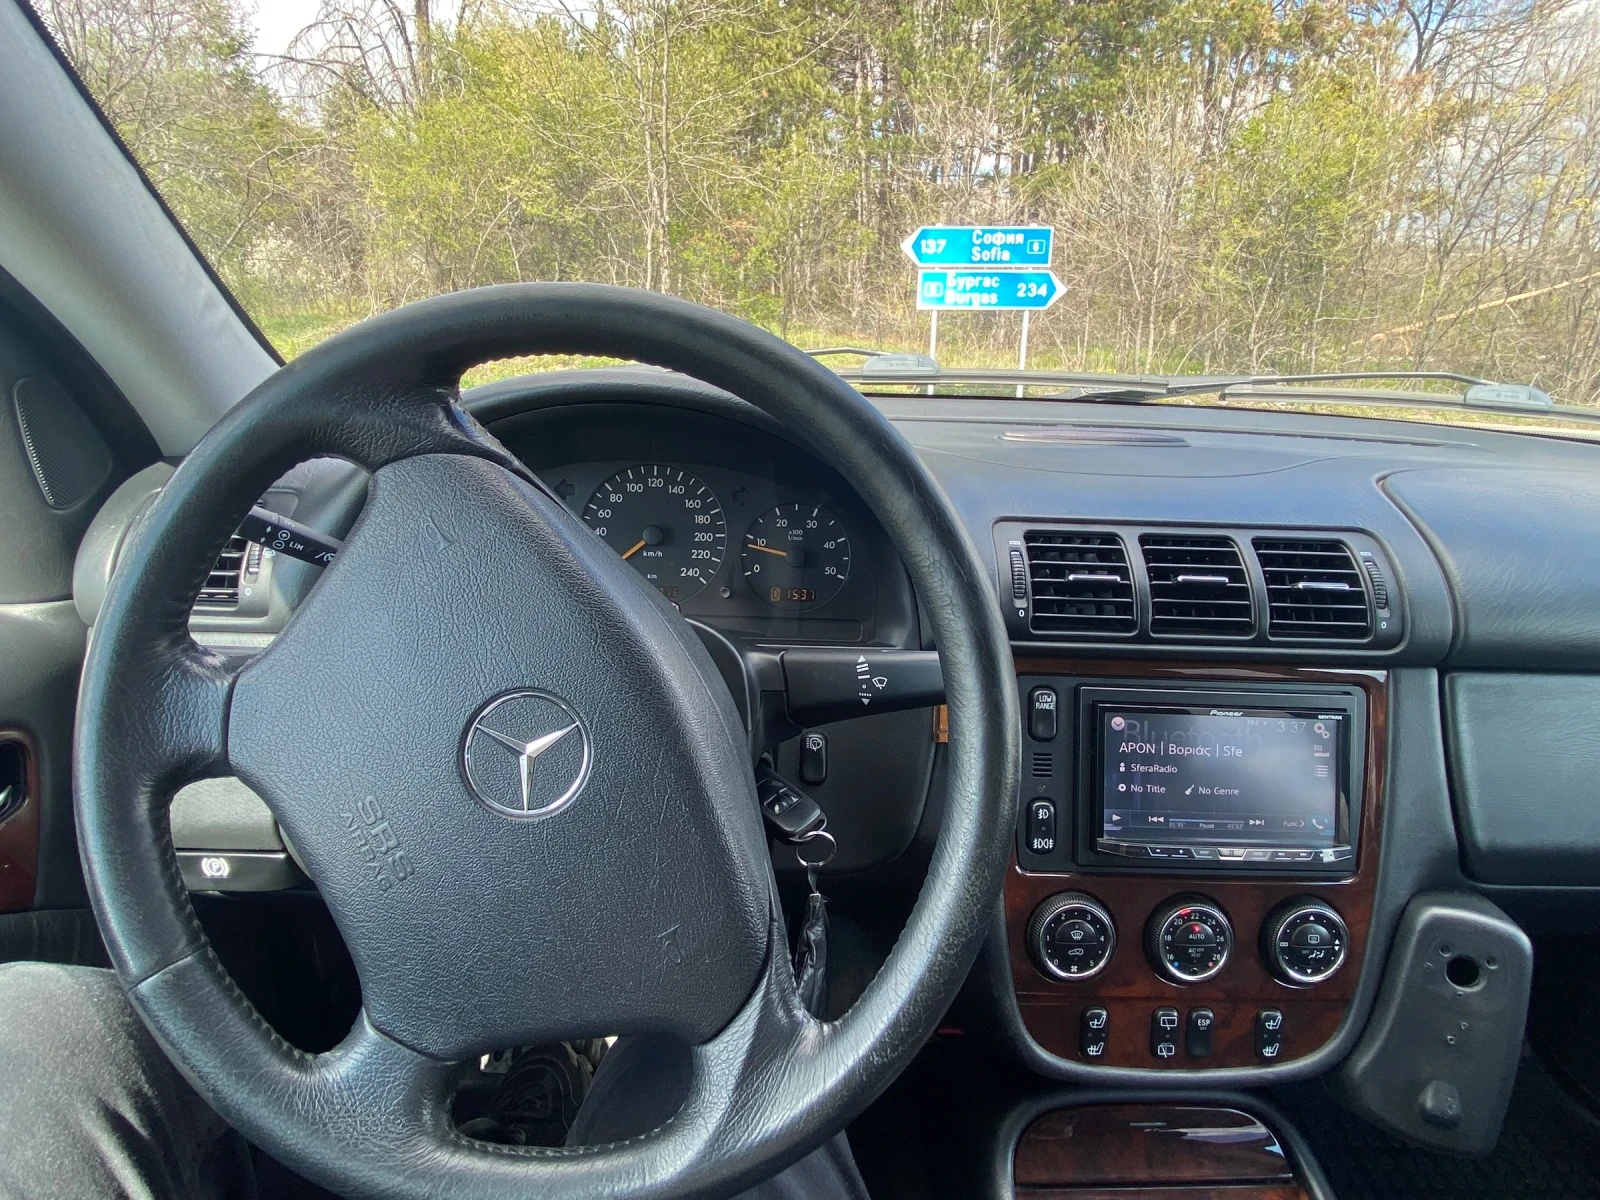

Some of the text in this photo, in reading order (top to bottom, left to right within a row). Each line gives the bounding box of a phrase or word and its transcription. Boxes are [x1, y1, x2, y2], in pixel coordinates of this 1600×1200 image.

[972, 229, 1025, 246] София
[920, 239, 947, 255] 137
[971, 246, 1011, 261] Sofia
[946, 273, 1000, 292] Бургас
[1016, 282, 1048, 298] 234
[648, 478, 664, 487] 120
[626, 483, 644, 492] 100
[668, 485, 685, 494] 140
[609, 494, 623, 502] 80
[685, 500, 702, 508] 160
[597, 509, 612, 518] 60
[694, 515, 711, 524] 180
[776, 519, 788, 527] 20
[806, 520, 818, 528] 30
[594, 527, 607, 536] 40
[694, 533, 714, 542] 200
[288, 541, 304, 551] LIM
[757, 538, 766, 547] 10
[823, 541, 835, 549] 40
[642, 550, 663, 558] km/h
[691, 550, 711, 559] 220
[680, 568, 700, 577] 240
[753, 564, 760, 572] 0
[824, 567, 836, 575] 50
[787, 589, 815, 600] 15:37
[1035, 702, 1055, 710] RANGE
[1210, 709, 1243, 717] Pioneer
[1119, 742, 1156, 754] APON
[1223, 745, 1243, 757] Sfe
[1130, 763, 1178, 774] SferaRadio
[1130, 784, 1166, 794] No Title
[1198, 787, 1240, 796] No Genre
[358, 795, 415, 881] SRS
[1197, 1018, 1210, 1026] ESP
